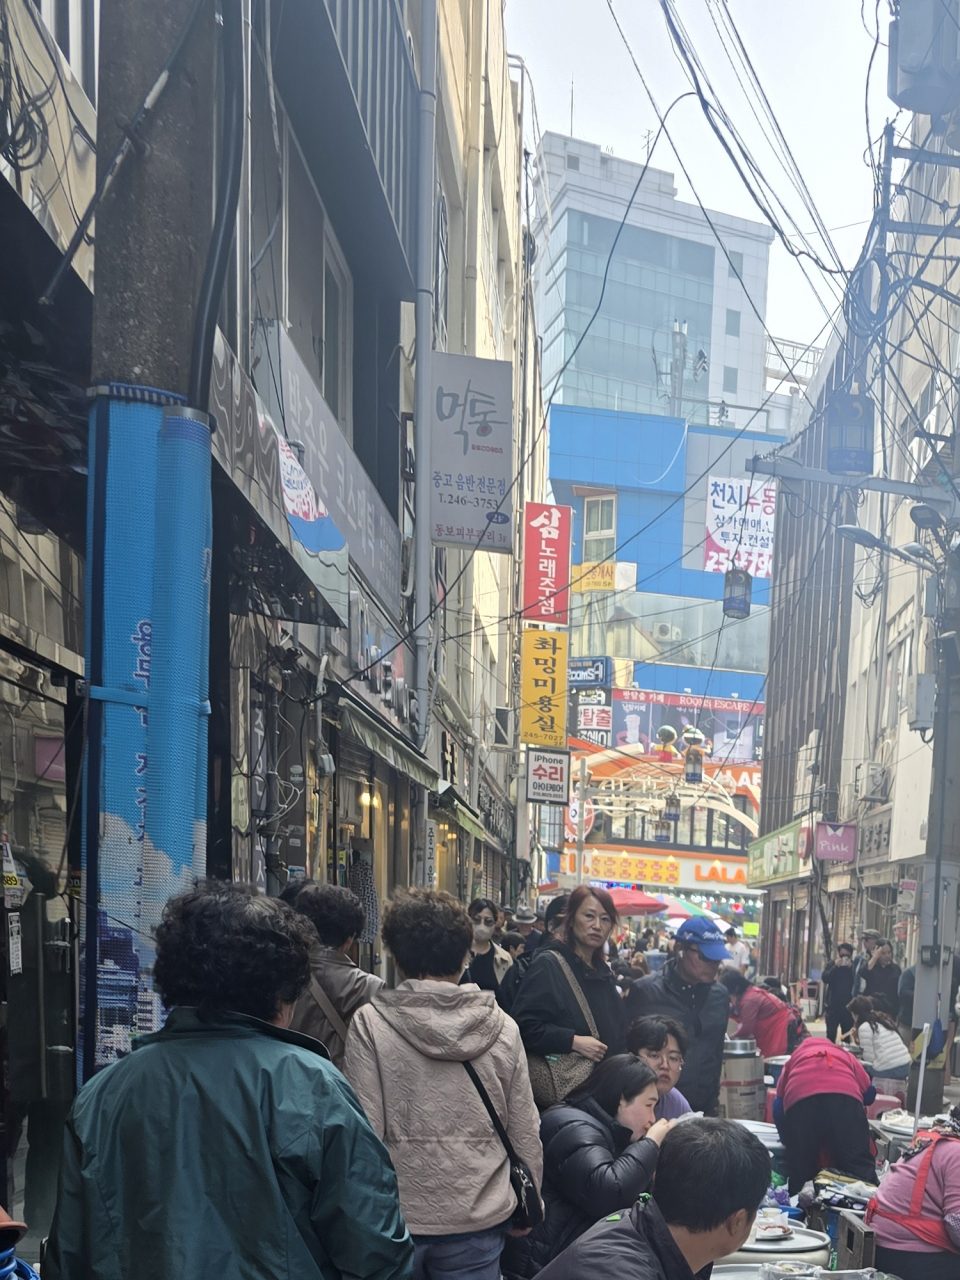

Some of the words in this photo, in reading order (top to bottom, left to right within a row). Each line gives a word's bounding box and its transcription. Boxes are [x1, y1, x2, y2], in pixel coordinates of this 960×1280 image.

[436, 379, 508, 456] 먹통
[433, 471, 453, 489] 중고
[456, 473, 475, 493] 음반
[714, 700, 750, 711] ESCAPE
[534, 754, 564, 765] iPhone
[532, 764, 564, 782] 수리
[819, 840, 849, 853] Pink
